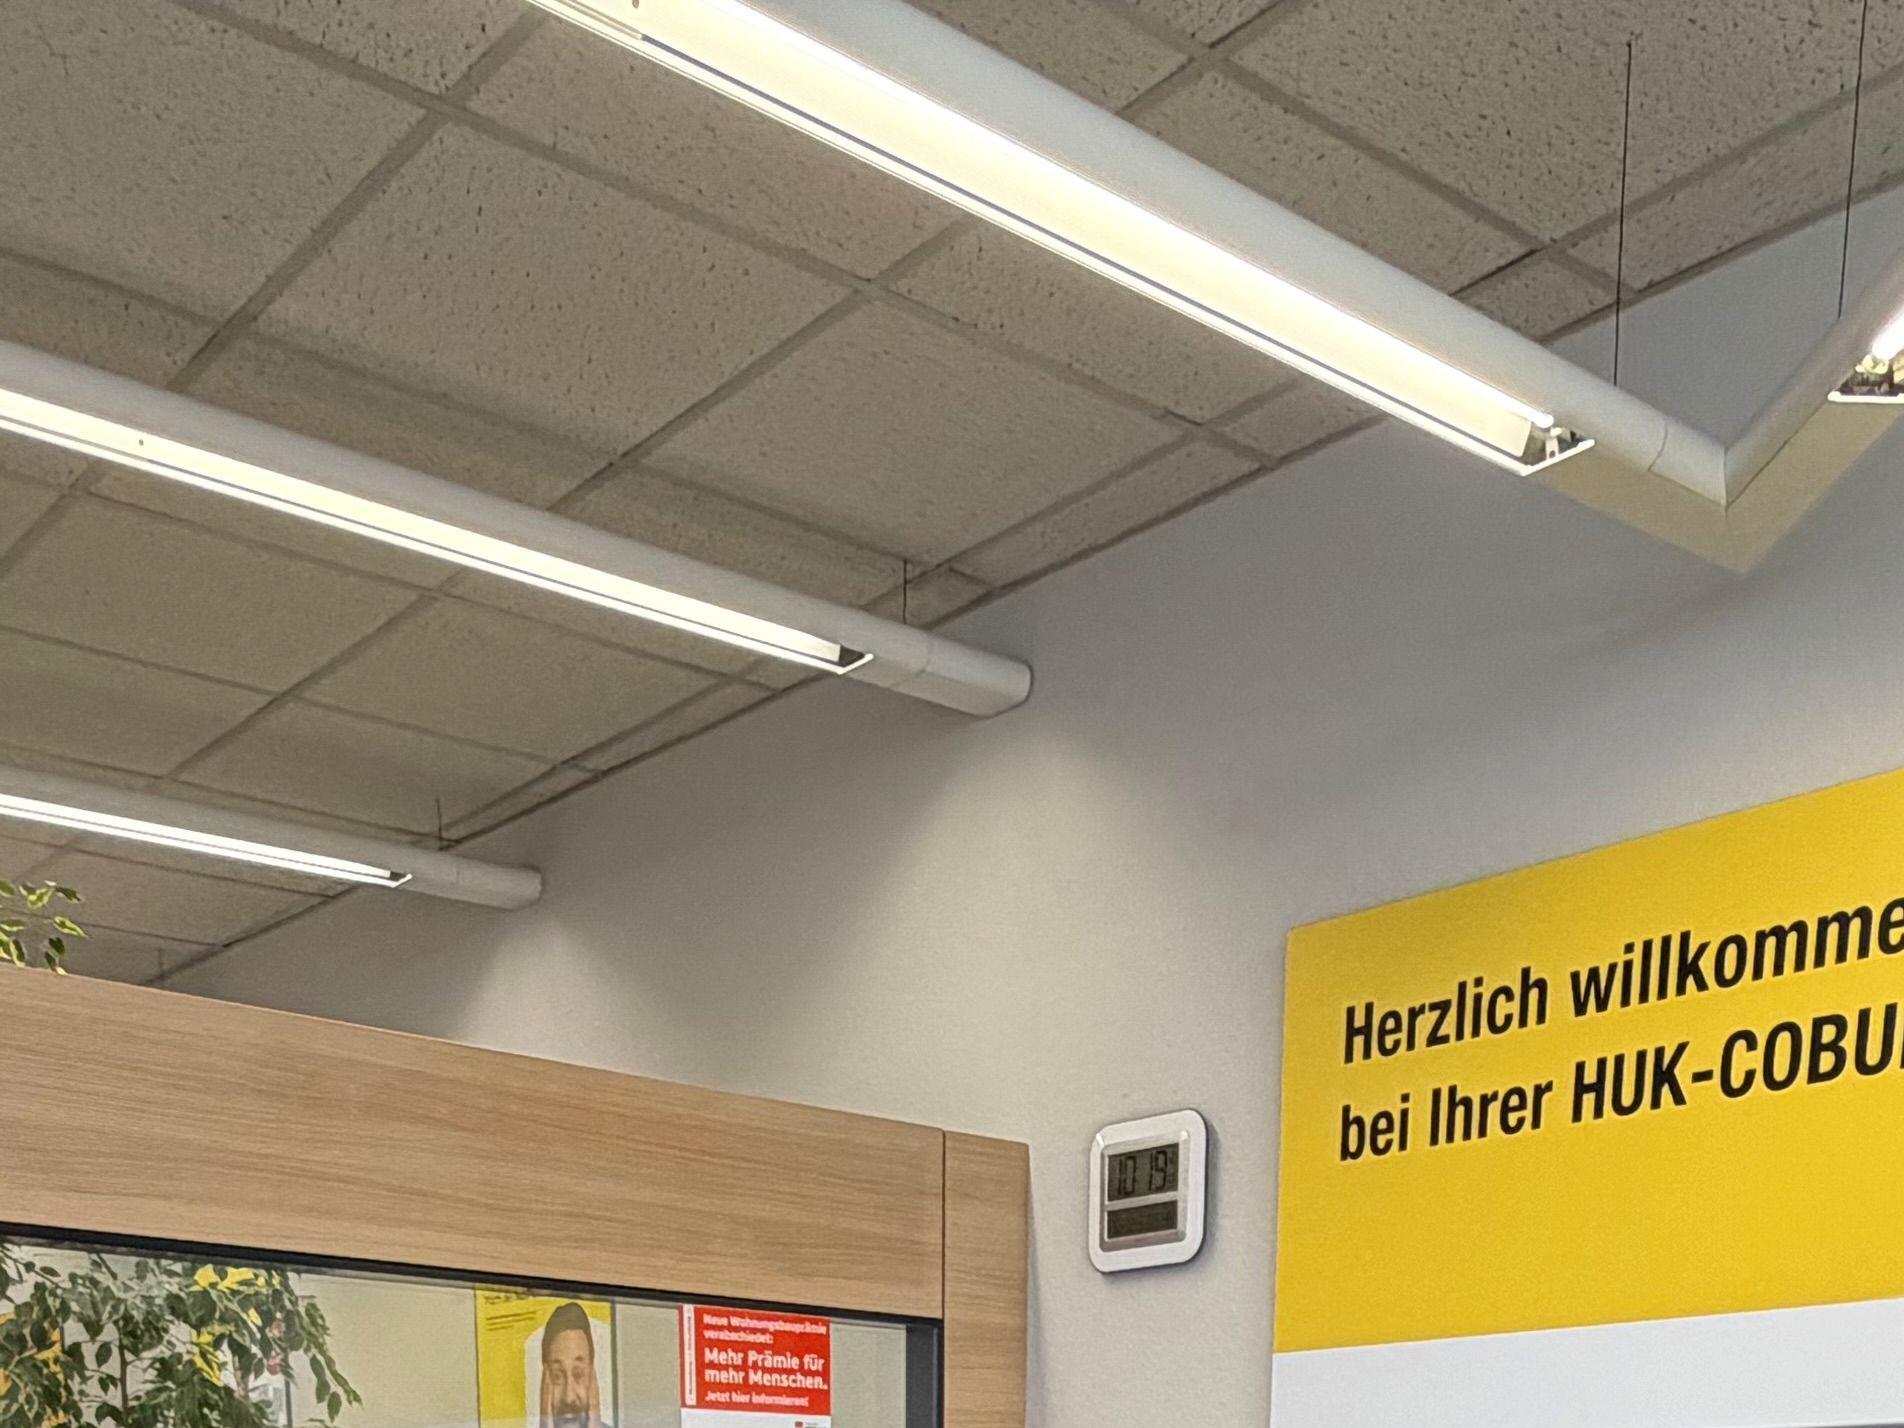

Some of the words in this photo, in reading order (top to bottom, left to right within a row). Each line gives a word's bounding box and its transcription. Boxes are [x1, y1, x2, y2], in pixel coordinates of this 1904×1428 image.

[1344, 965, 1549, 1064] Herzlich
[1339, 1096, 1410, 1161] bei
[1428, 1079, 1553, 1147] Ihrer
[704, 1347, 744, 1366] Mehr
[747, 1350, 800, 1370] Prämie
[803, 1353, 825, 1372] für
[704, 1367, 745, 1385] mehr
[748, 1368, 828, 1391] Menschen.
